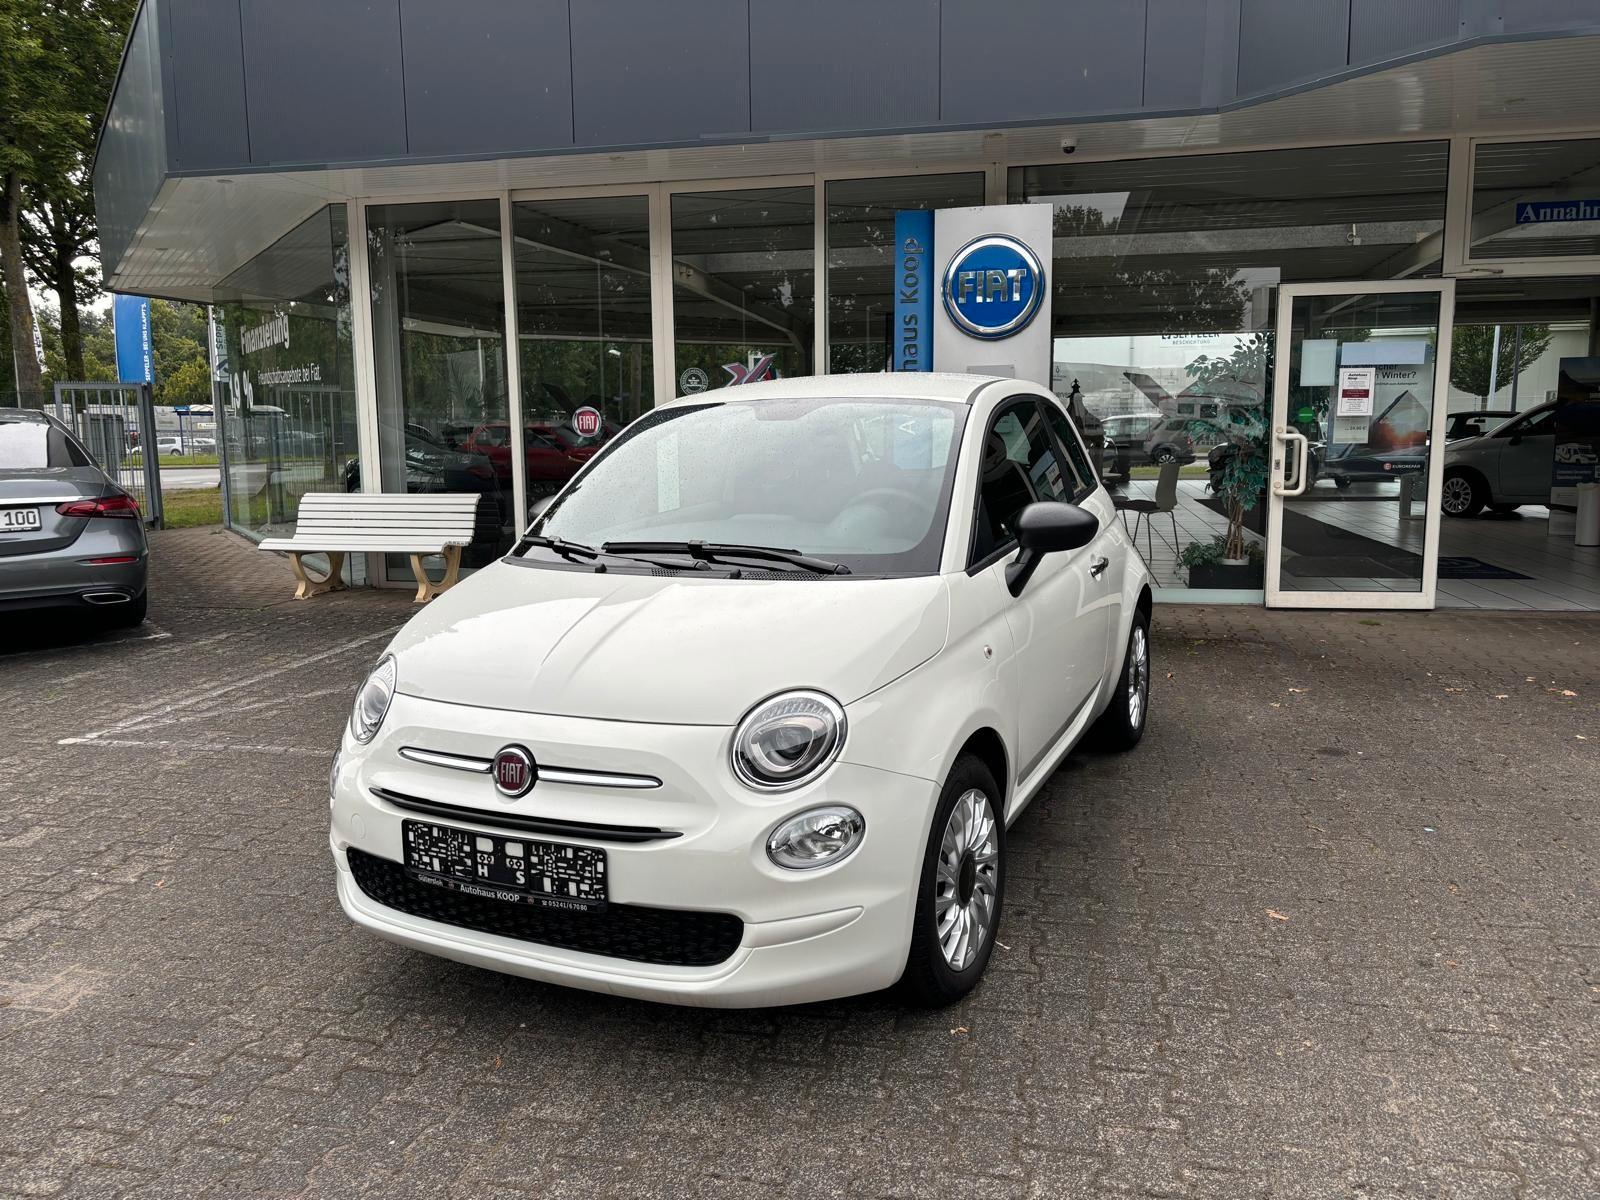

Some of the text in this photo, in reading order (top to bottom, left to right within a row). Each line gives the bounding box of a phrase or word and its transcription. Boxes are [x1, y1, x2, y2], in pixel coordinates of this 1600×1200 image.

[900, 238, 924, 304] Koop
[958, 268, 1027, 304] FIAT
[240, 315, 290, 355] Finanzierung
[1381, 371, 1417, 379] Winter?
[579, 415, 596, 430] FIAT
[4, 511, 37, 526] 100
[500, 761, 523, 784] FIAT
[418, 874, 444, 887] Gütersloh
[460, 883, 496, 899] Autohaus
[496, 892, 520, 903] KOOP
